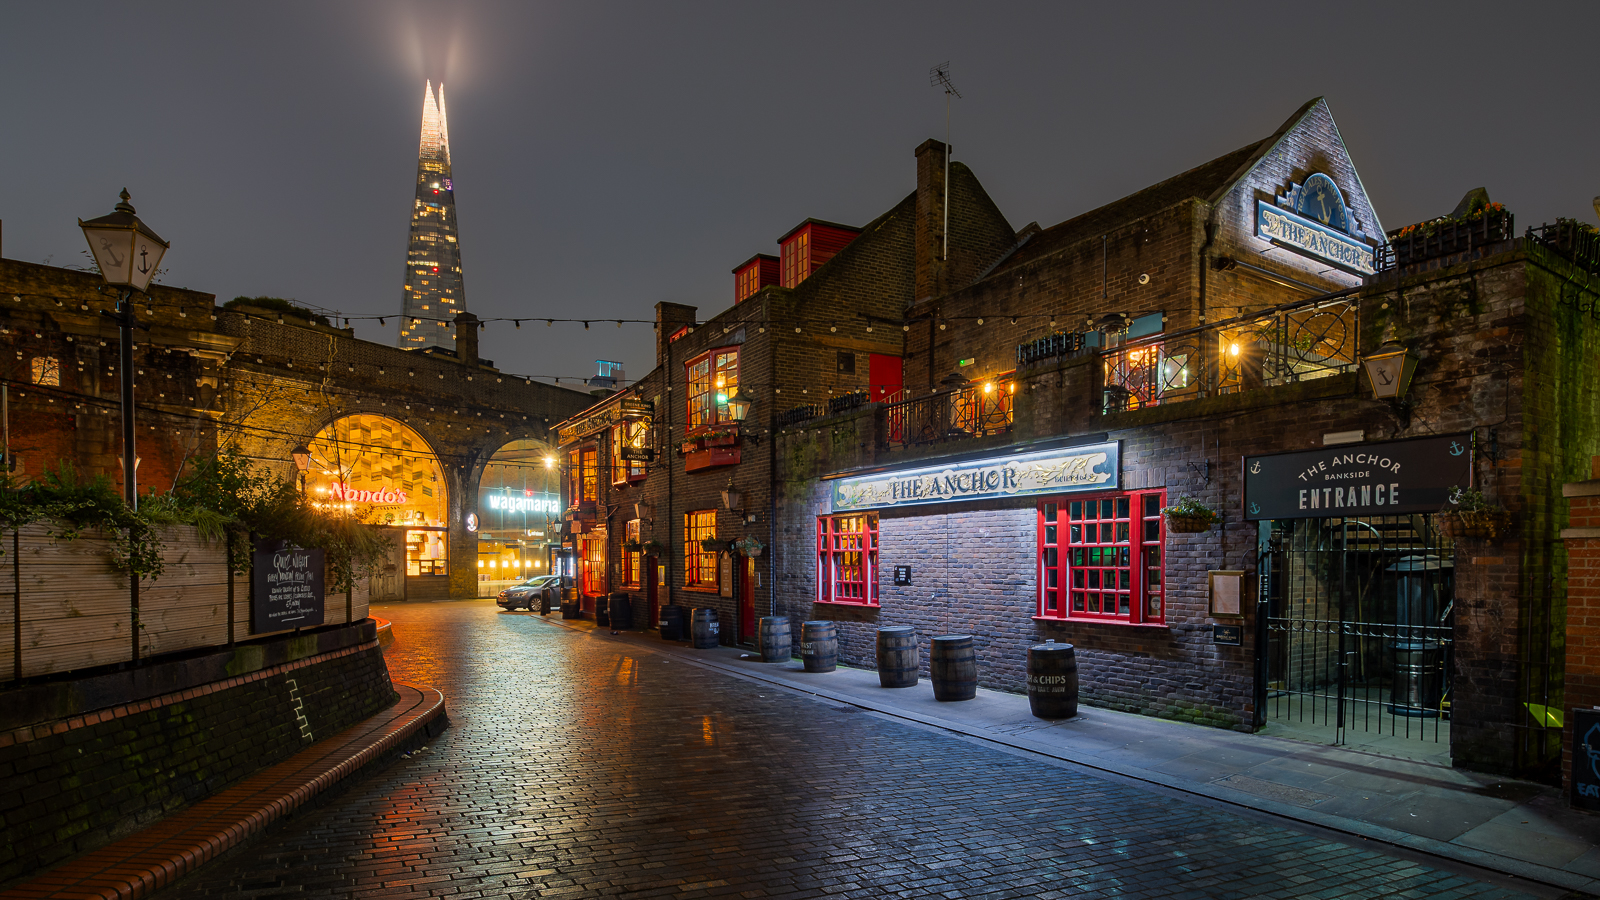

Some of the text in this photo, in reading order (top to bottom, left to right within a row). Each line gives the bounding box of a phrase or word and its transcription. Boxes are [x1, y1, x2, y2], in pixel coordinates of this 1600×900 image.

[1298, 187, 1308, 212] REAL
[1336, 198, 1346, 229] FOOD
[1281, 219, 1360, 267] THE ANCHOR
[1299, 453, 1401, 482] THE ANCHOR
[1325, 470, 1370, 481] BANKSIDE
[329, 482, 407, 504] Nando's
[892, 468, 1018, 499] THE ANCHOR
[1299, 482, 1399, 509] ENTRANCE
[489, 495, 559, 513] wagamama
[1039, 675, 1066, 684] CHIPS
